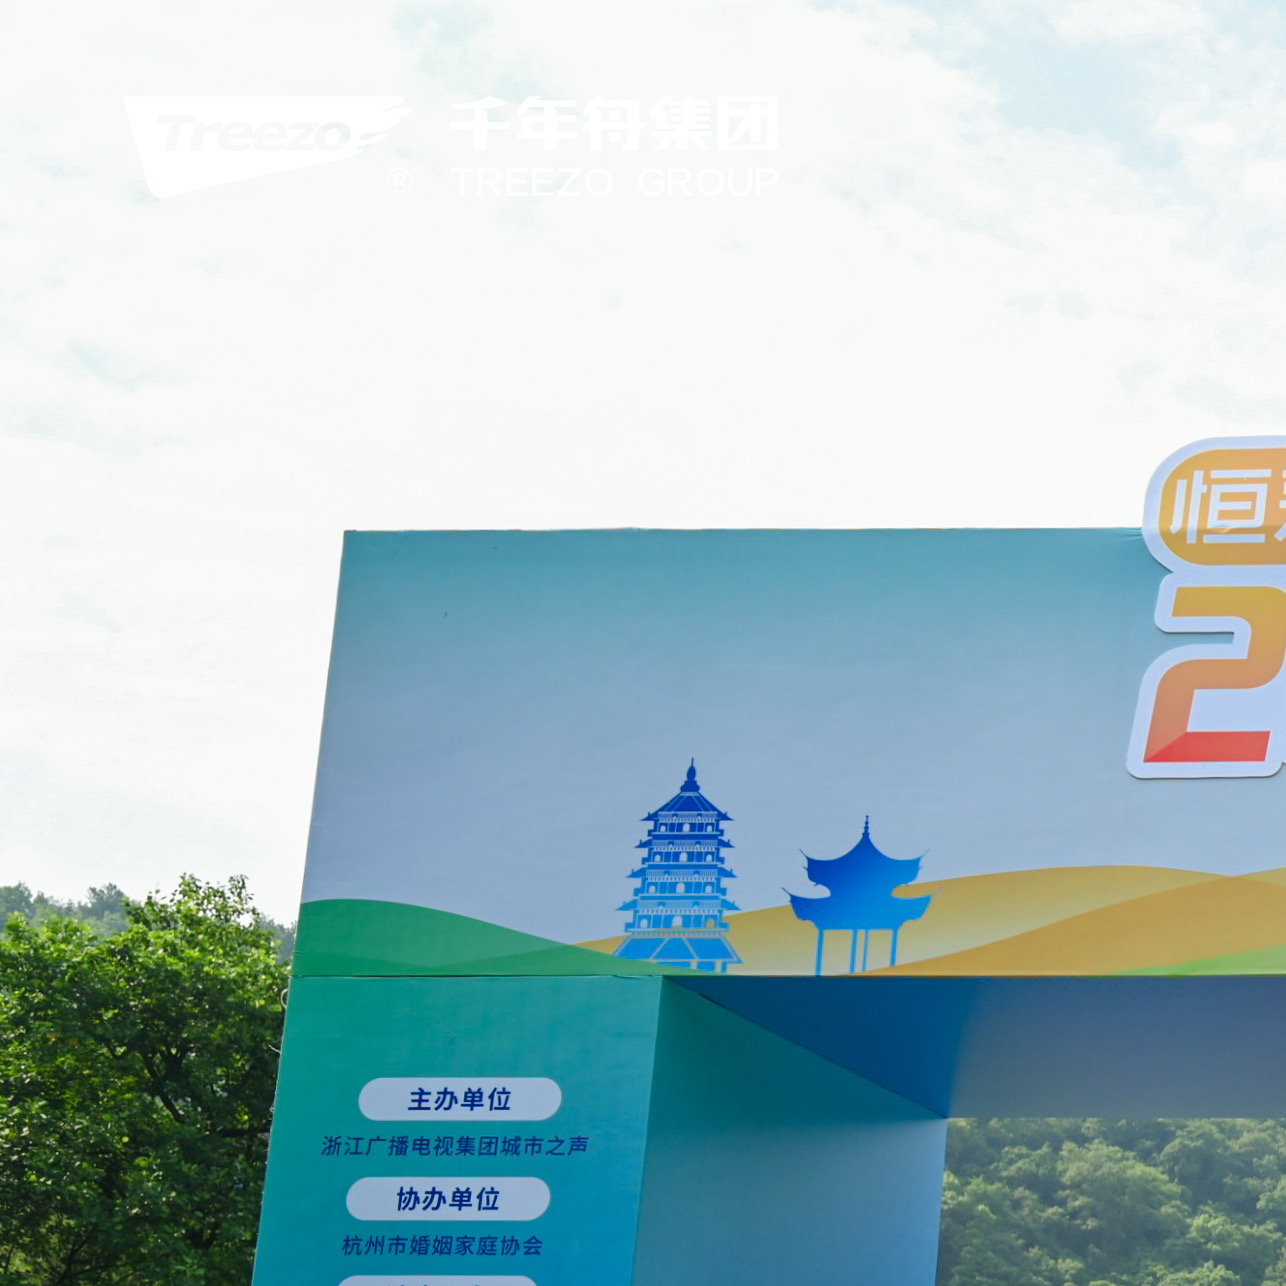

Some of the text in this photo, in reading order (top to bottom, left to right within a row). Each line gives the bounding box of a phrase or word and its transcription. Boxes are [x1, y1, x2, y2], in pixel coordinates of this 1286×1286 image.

[407, 1087, 512, 1112] 主办单位
[320, 1135, 590, 1157] 浙江广播电视集团城市之声
[396, 1186, 500, 1212] 协办单位
[341, 1234, 544, 1257] 杭州市婚姻家庭协会
